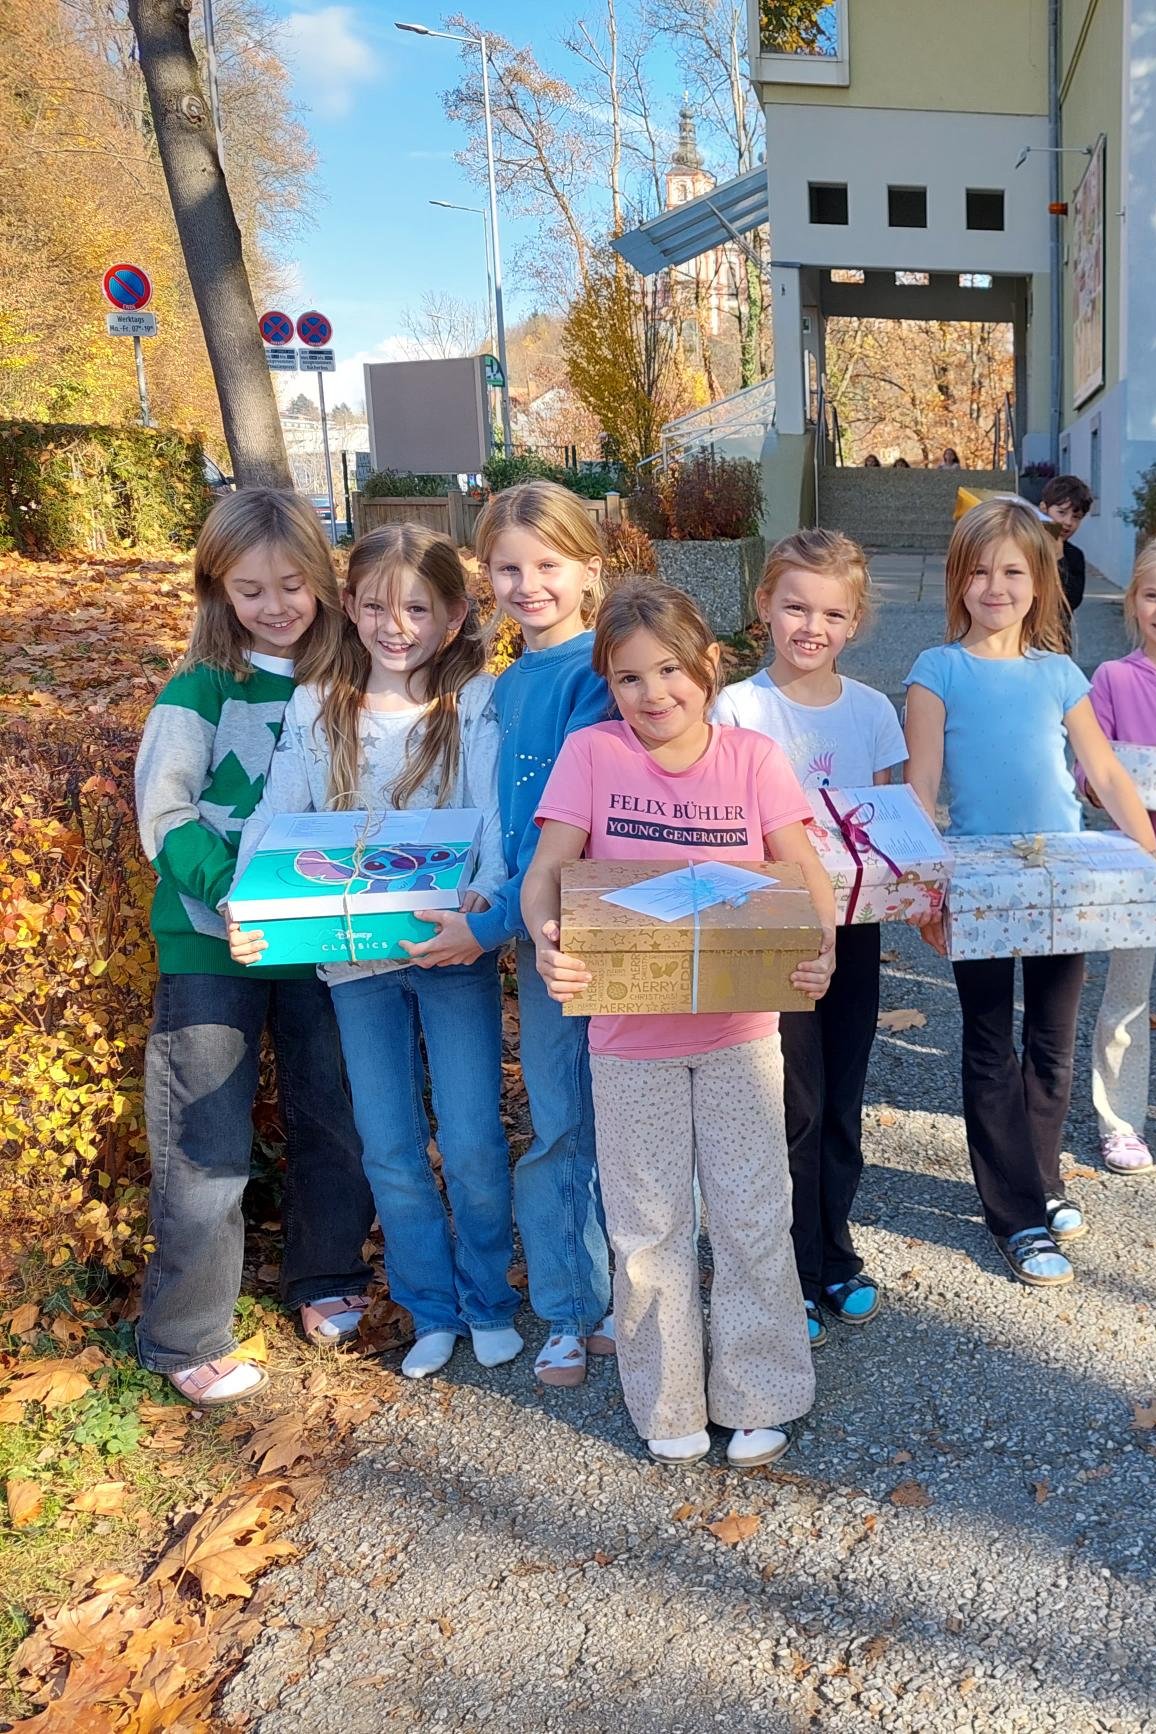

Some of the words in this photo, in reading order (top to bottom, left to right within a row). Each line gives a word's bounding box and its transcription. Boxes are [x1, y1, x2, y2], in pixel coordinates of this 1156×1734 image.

[117, 315, 145, 324] Werktags
[608, 793, 668, 817] FELIX
[672, 801, 746, 821] BÜHLER
[608, 820, 660, 838] YOUNG
[662, 828, 747, 844] GENERATION
[321, 941, 388, 951] CLASICS
[630, 952, 641, 981] MERR
[629, 981, 679, 993] MERRY
[629, 993, 678, 1001] CHRISTMAS!
[599, 1002, 645, 1014] MERRY
